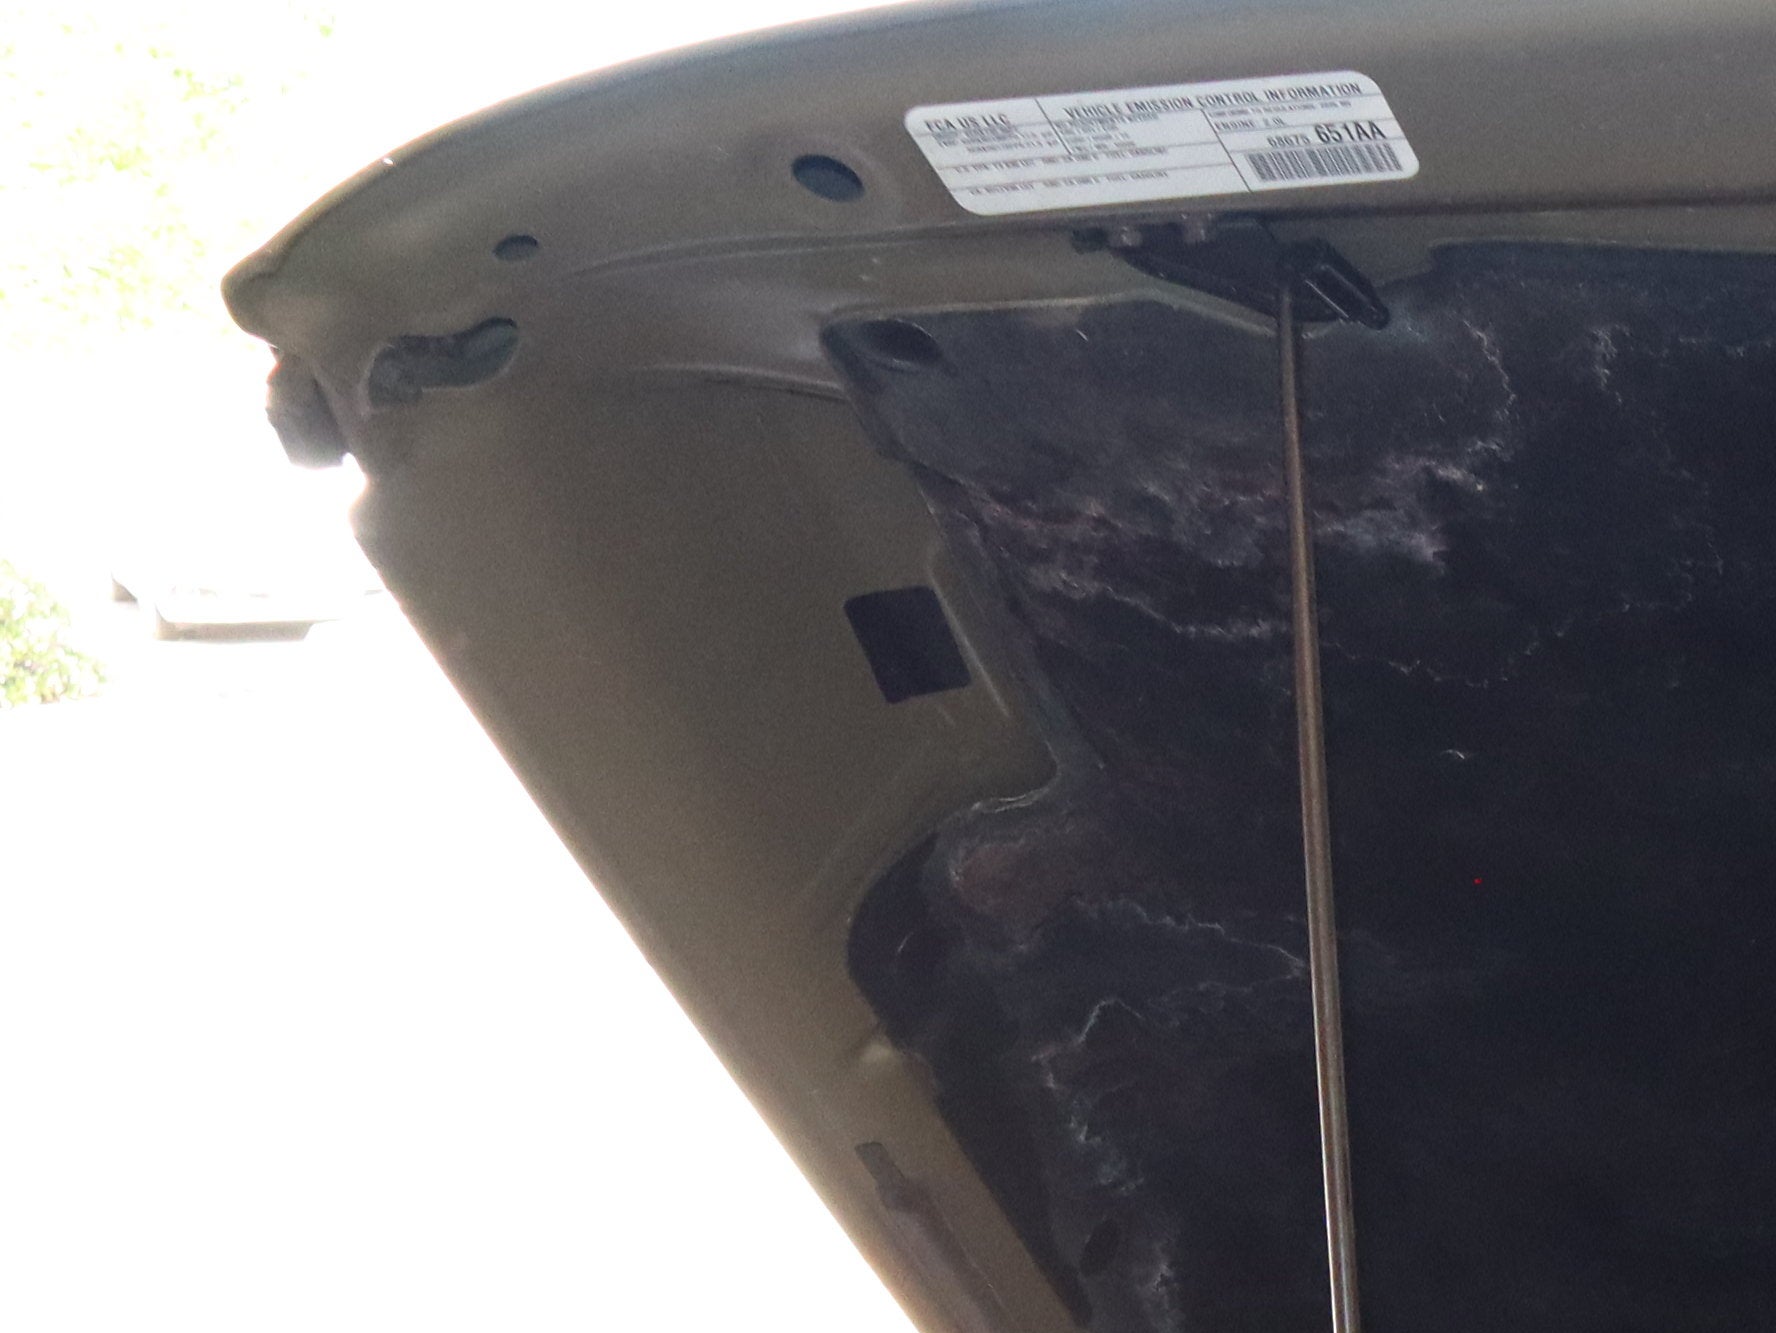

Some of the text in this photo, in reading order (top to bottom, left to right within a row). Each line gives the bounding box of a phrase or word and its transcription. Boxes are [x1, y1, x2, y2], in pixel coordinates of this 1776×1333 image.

[1064, 103, 1122, 118] VEHICLE
[1125, 96, 1195, 114] EMISSION
[1196, 90, 1259, 107] CONTROL
[1264, 83, 1363, 101] INFORMATION
[1314, 119, 1387, 144] 651AA
